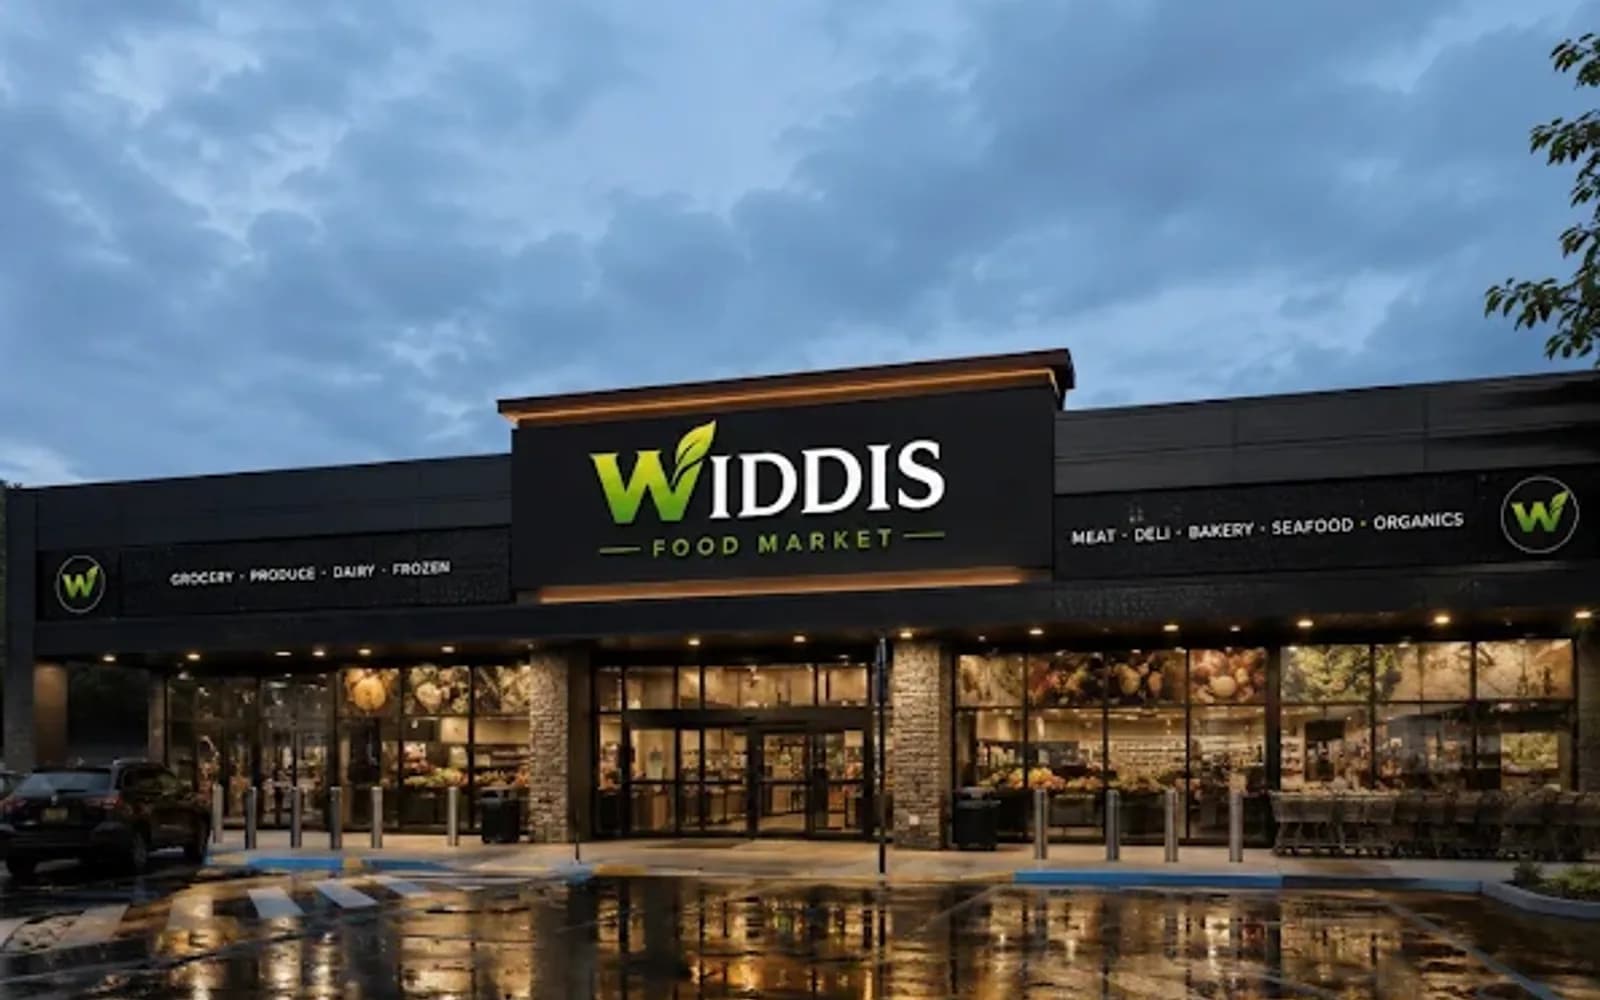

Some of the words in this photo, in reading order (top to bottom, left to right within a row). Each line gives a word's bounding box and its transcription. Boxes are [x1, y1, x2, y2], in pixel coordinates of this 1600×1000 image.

[591, 420, 946, 524] WIDDIS
[1510, 488, 1571, 533] W
[652, 535, 740, 558] FOOD
[757, 528, 894, 554] MARKET
[1071, 528, 1117, 545] MEAT
[1134, 525, 1171, 542] DELI
[1188, 522, 1255, 540] BAKERY
[1271, 517, 1354, 536] SEAFOOD
[1373, 512, 1465, 531] ORGANICS
[61, 566, 99, 599] W
[169, 570, 234, 587] GROCERY
[249, 566, 316, 582] PRODUCE
[332, 564, 376, 579] DAIRY
[392, 560, 451, 576] FROZEN
